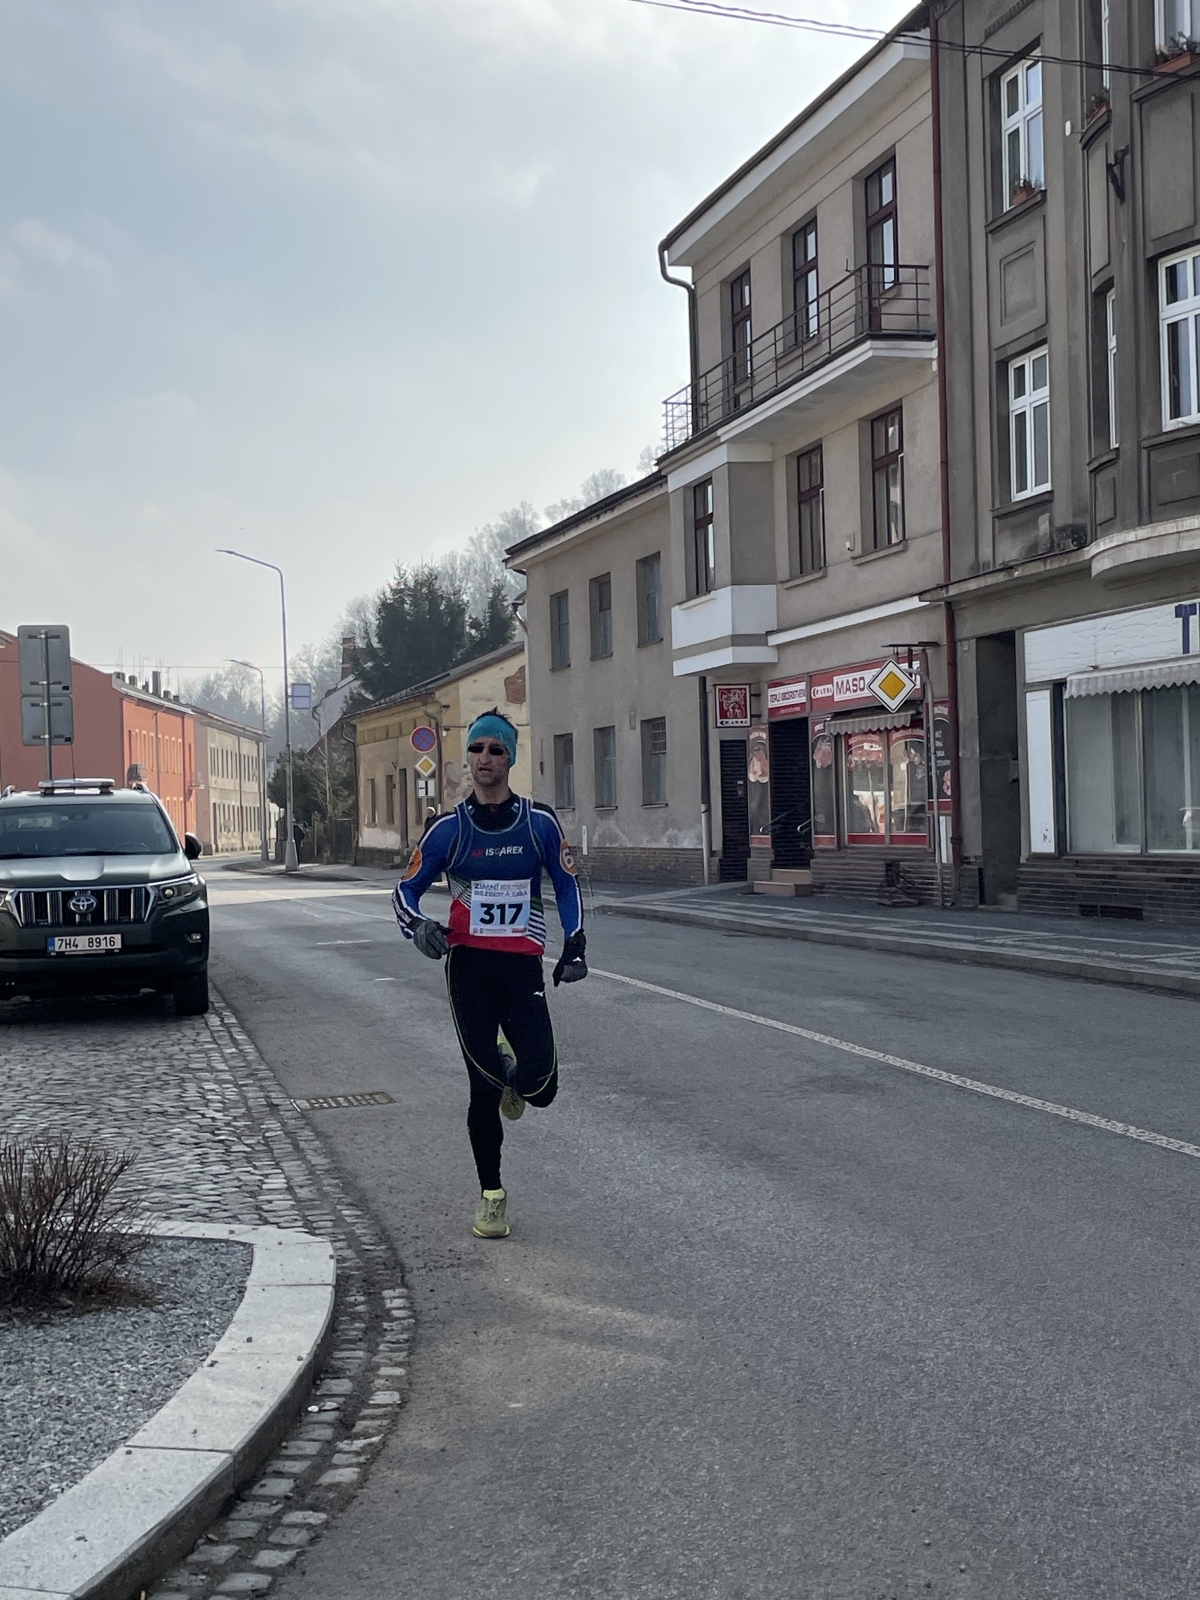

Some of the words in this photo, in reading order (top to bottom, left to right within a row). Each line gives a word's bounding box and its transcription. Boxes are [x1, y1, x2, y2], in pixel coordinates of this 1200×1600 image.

[1174, 602, 1200, 655] T
[835, 676, 866, 696] MASO
[479, 903, 523, 925] 317
[57, 938, 79, 950] 7H4
[87, 936, 116, 948] 8916
